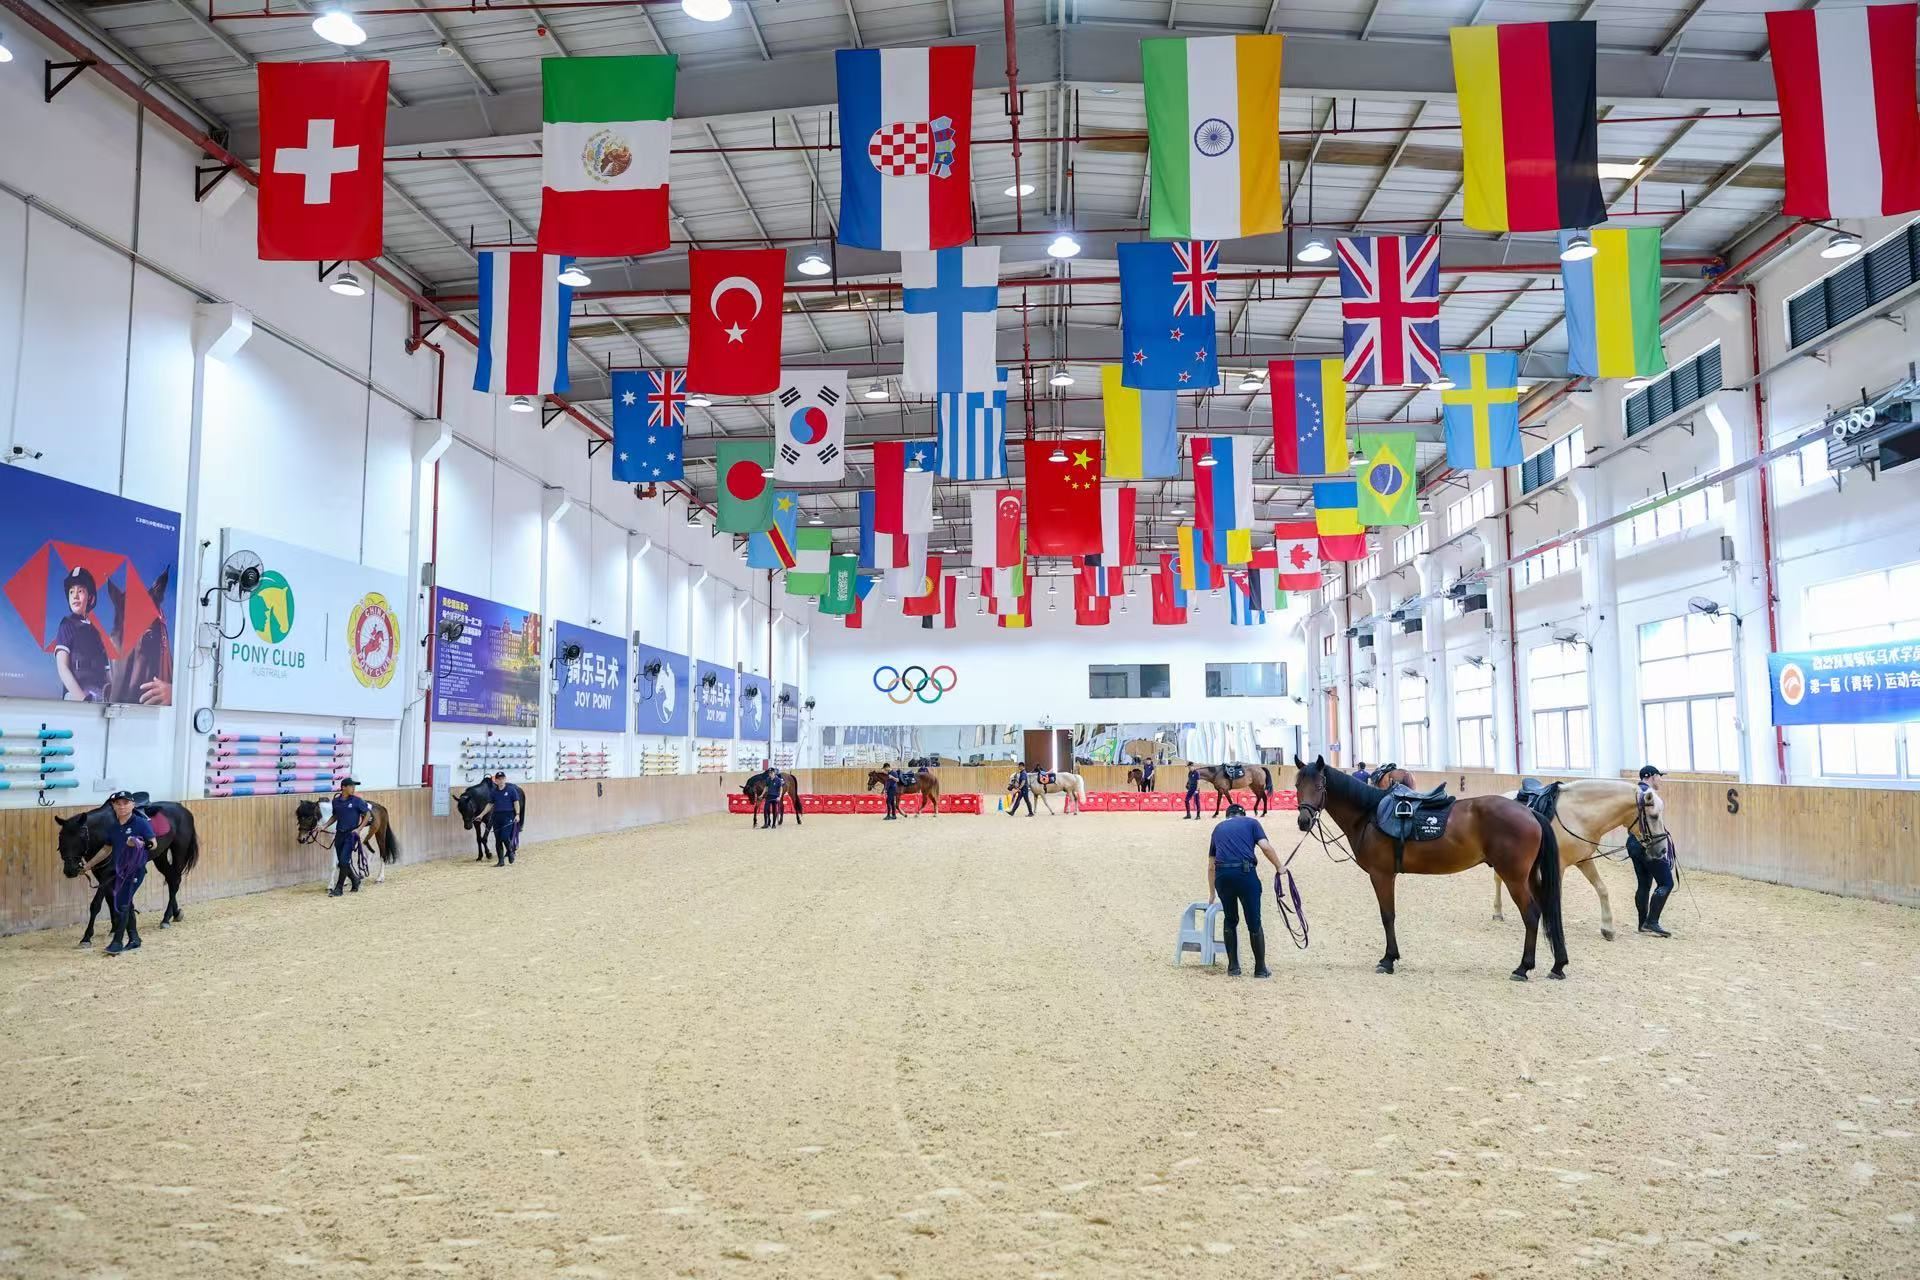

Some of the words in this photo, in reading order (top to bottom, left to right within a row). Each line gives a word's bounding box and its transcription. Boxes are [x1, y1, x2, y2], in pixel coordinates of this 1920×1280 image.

[364, 606, 386, 621] CHINA
[231, 643, 269, 664] PONY
[272, 648, 305, 668] CLUB
[357, 652, 374, 676] PONY
[375, 655, 392, 677] CLUB
[252, 667, 288, 679] AUSTRALIA
[567, 652, 619, 690] 骑乐马术
[574, 690, 591, 708] JOY
[592, 692, 612, 710] PONY
[1726, 788, 1740, 815] S
